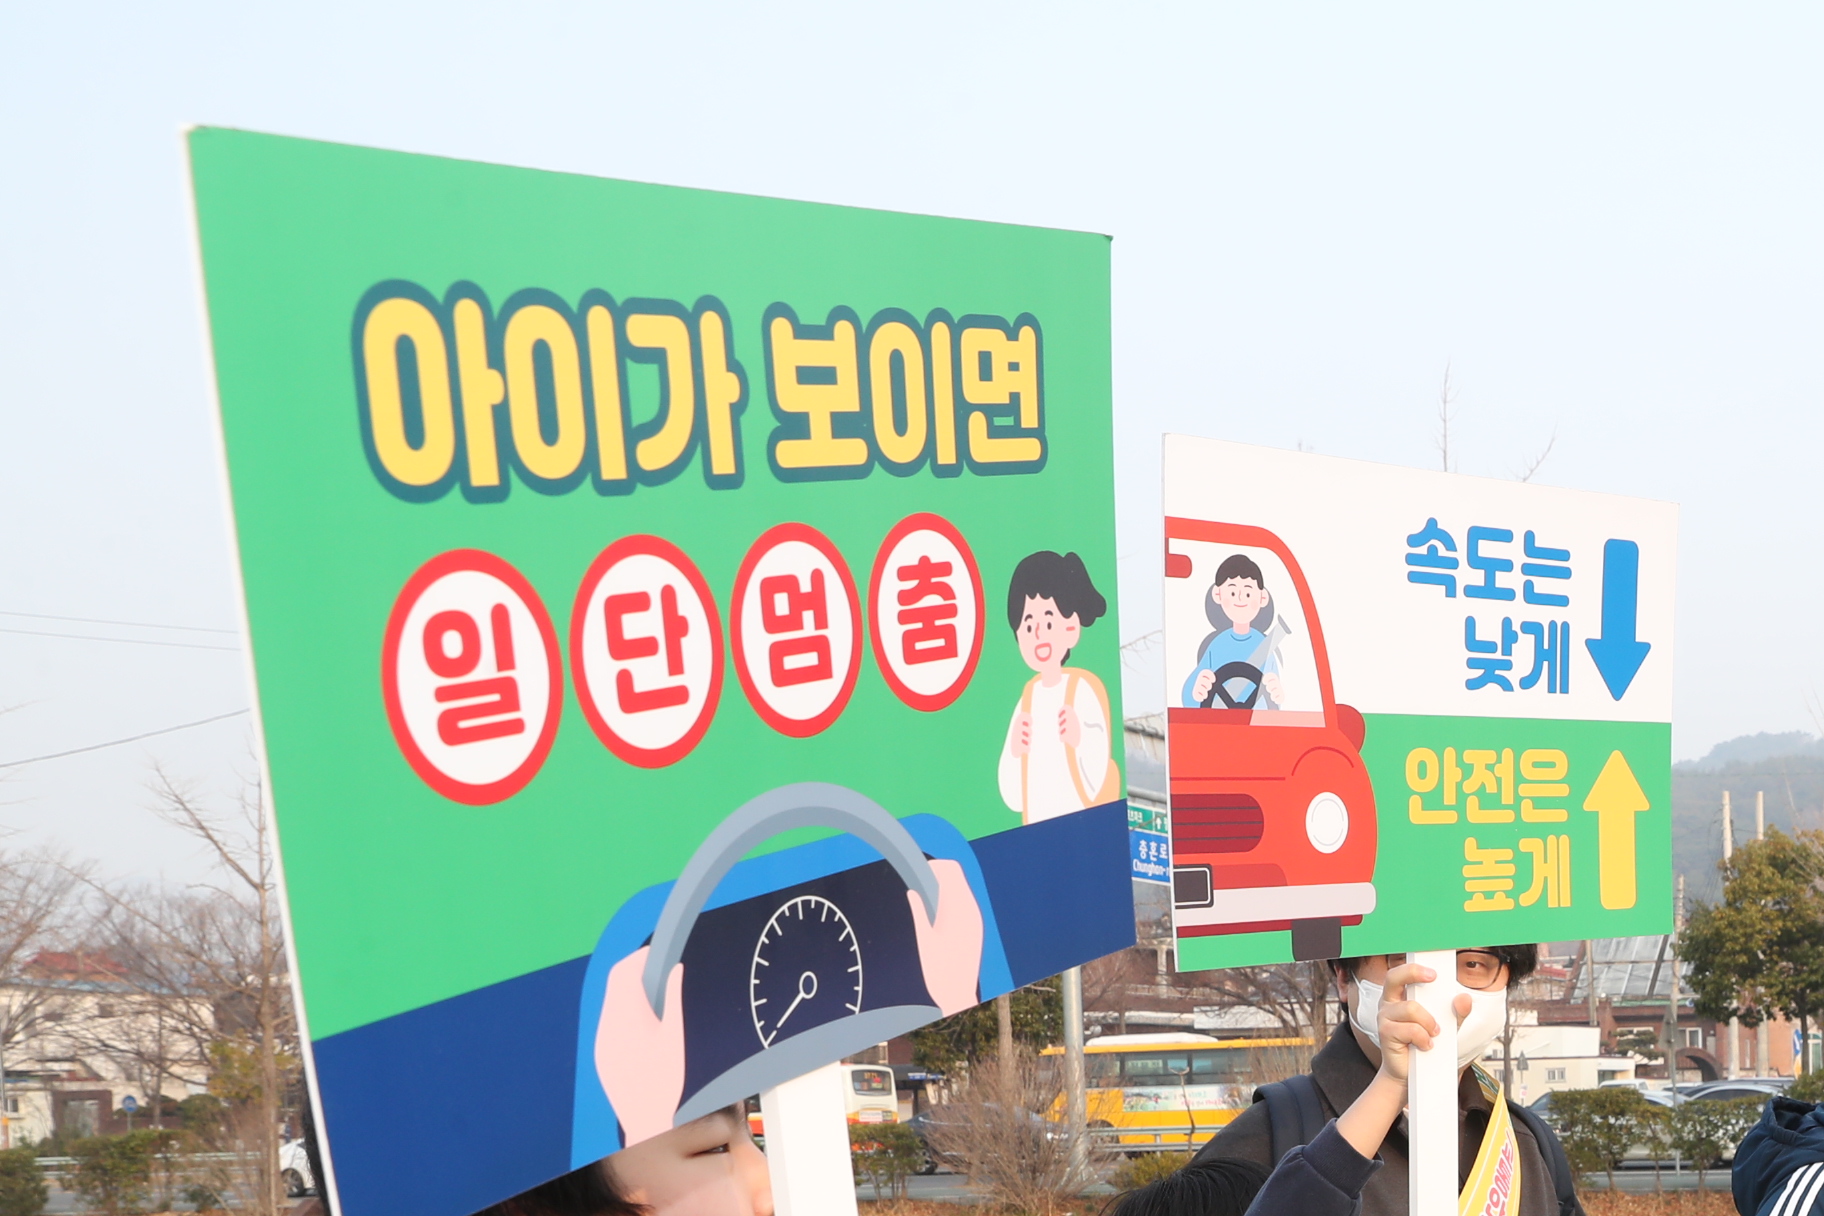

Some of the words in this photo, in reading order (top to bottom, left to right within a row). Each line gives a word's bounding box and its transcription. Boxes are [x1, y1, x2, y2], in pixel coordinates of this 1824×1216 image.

[355, 285, 746, 498] 아이가
[764, 308, 1046, 476] 보이면
[1404, 516, 1573, 608] 속도는
[421, 600, 528, 748] 일
[602, 582, 692, 716] 단
[757, 566, 835, 690] 멈
[894, 553, 961, 667] 춤
[1464, 615, 1571, 695] 낮게
[1404, 745, 1571, 825] 안전은
[1133, 859, 1169, 876] Chunghon-r
[1138, 839, 1168, 861] 충혼로
[1462, 833, 1572, 913] 높게
